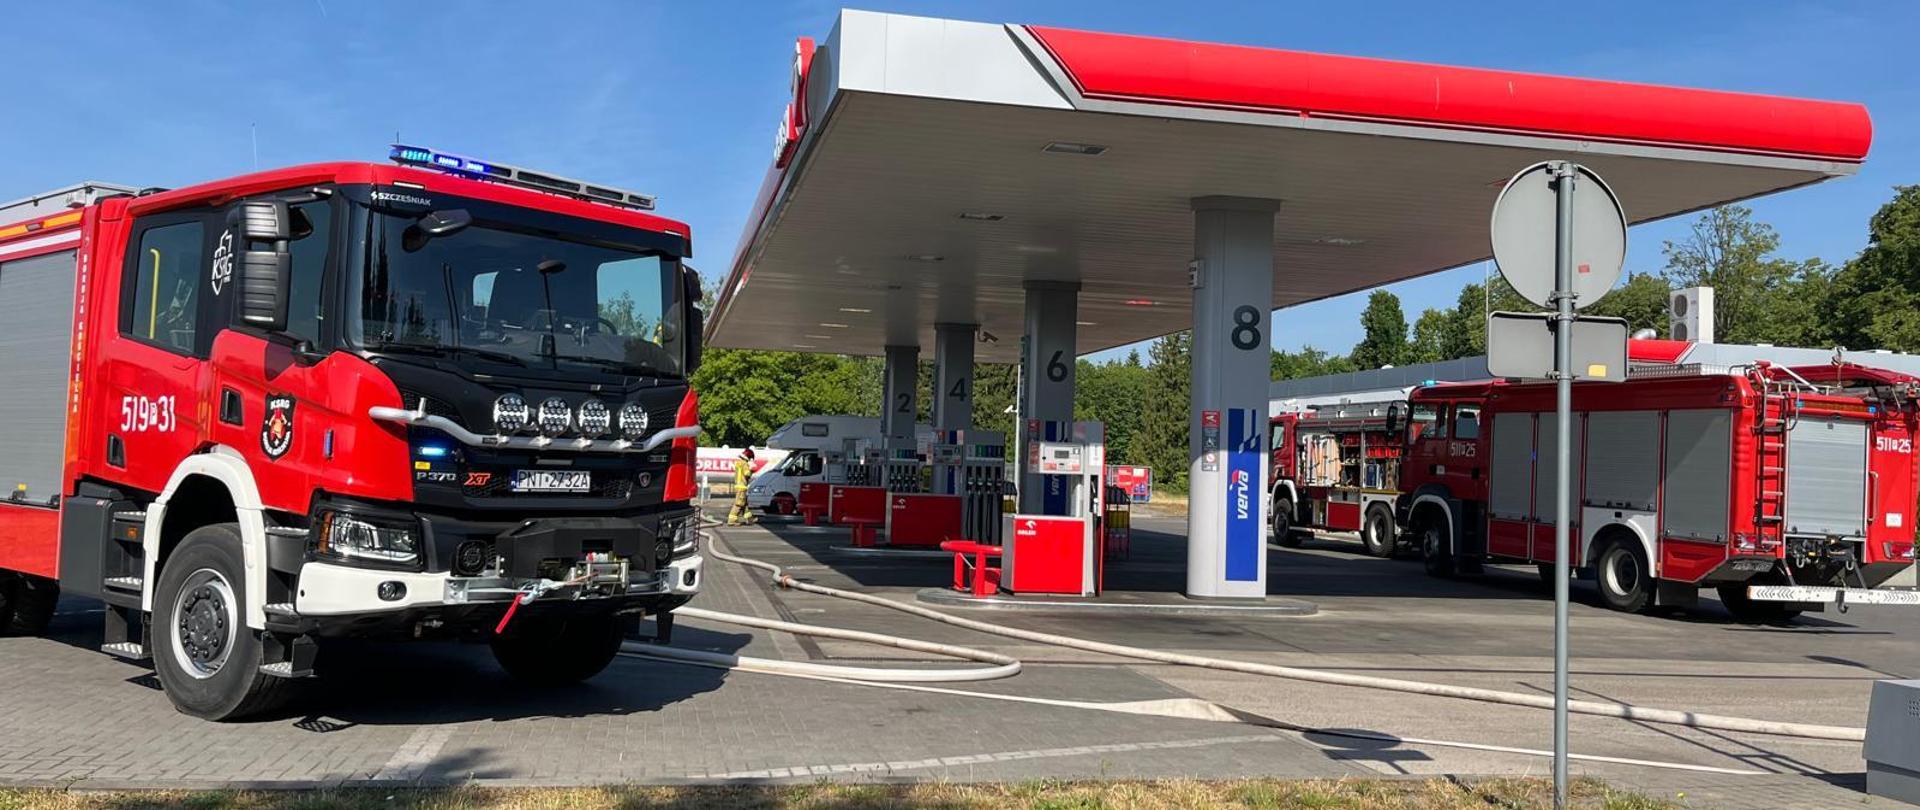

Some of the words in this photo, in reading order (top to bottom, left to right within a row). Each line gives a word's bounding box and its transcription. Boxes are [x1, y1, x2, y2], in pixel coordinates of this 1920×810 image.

[1231, 305, 1261, 350] 8
[1047, 350, 1068, 382] 6
[949, 378, 967, 402] 4
[270, 399, 290, 410] KSRG
[898, 393, 911, 413] 2
[696, 459, 736, 470] ORLEN
[416, 472, 427, 480] P
[428, 472, 457, 481] 370
[464, 472, 491, 486] XT
[518, 471, 545, 487] PNT
[549, 472, 589, 488] 2732A
[1237, 470, 1249, 520] verva
